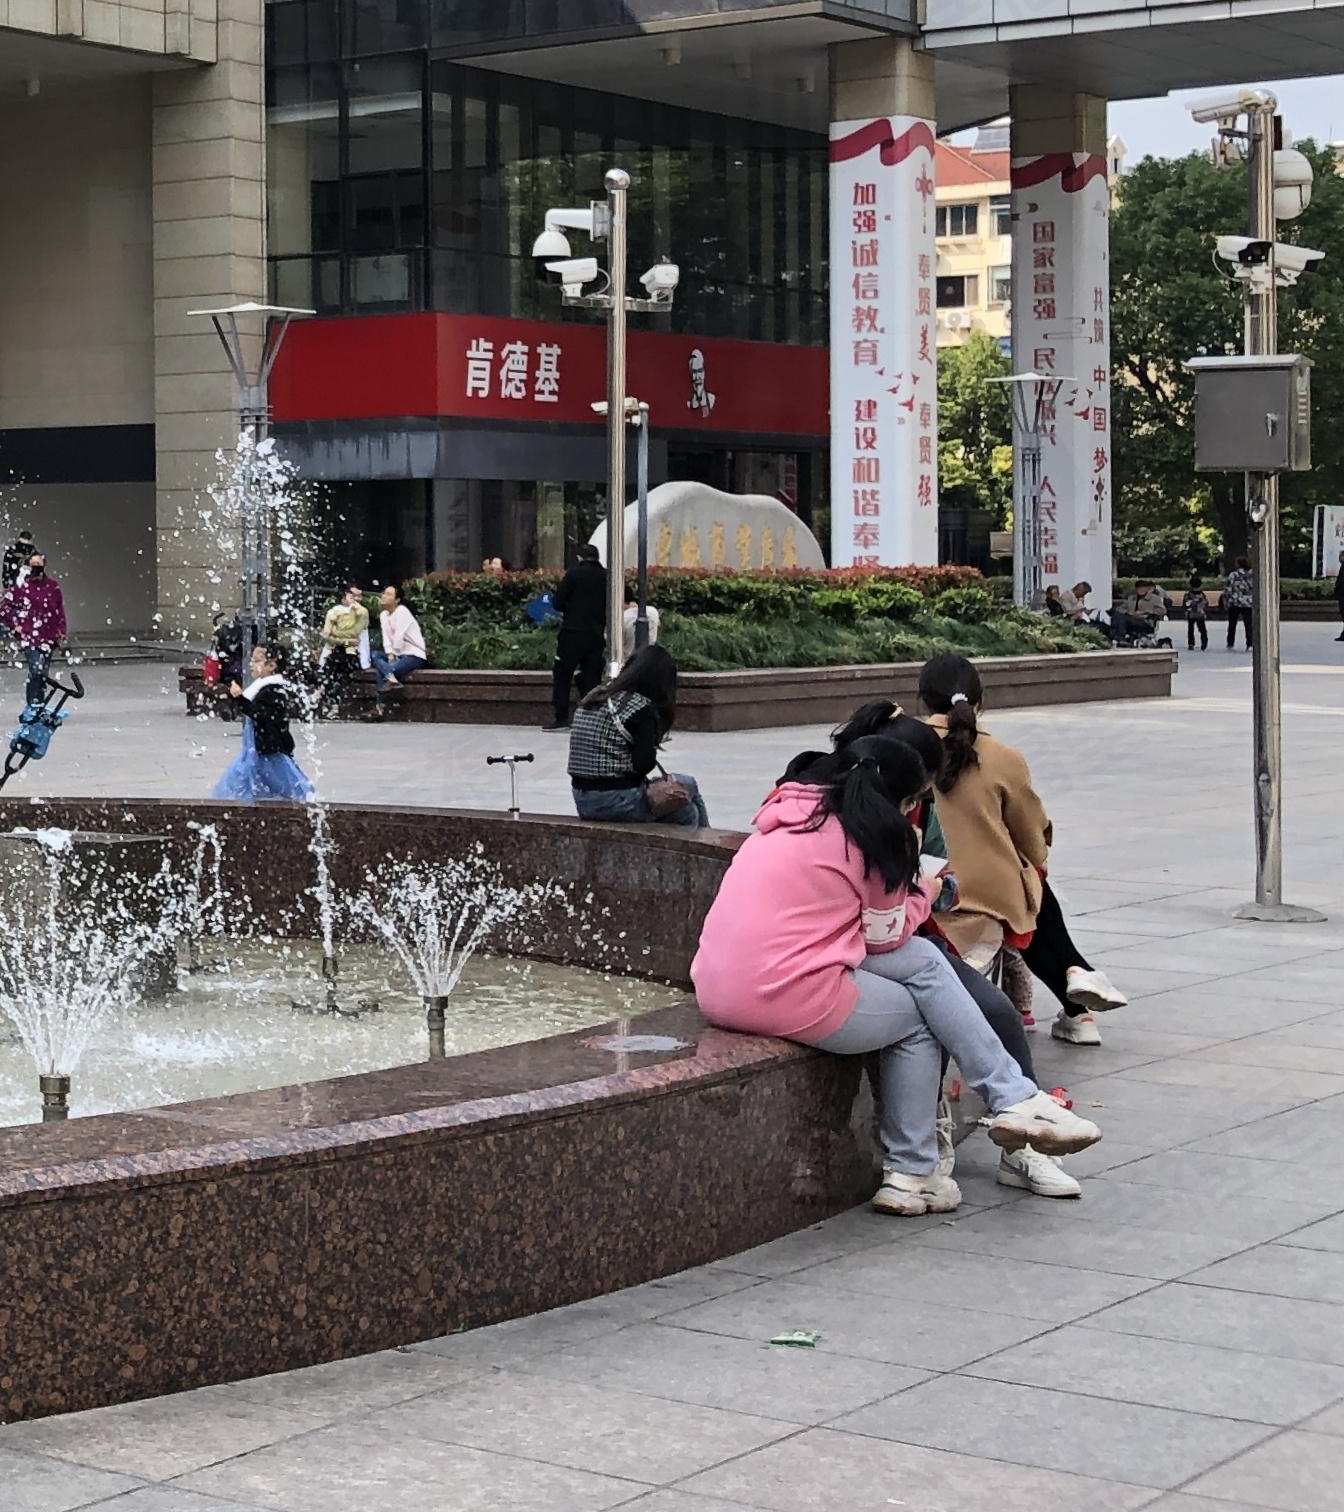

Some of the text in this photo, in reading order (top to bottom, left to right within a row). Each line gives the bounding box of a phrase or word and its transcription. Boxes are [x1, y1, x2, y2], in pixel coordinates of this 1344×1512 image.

[852, 182, 880, 366] 加强诚信教育
[1033, 221, 1056, 320] 国家富强
[466, 338, 562, 402] 肯德基
